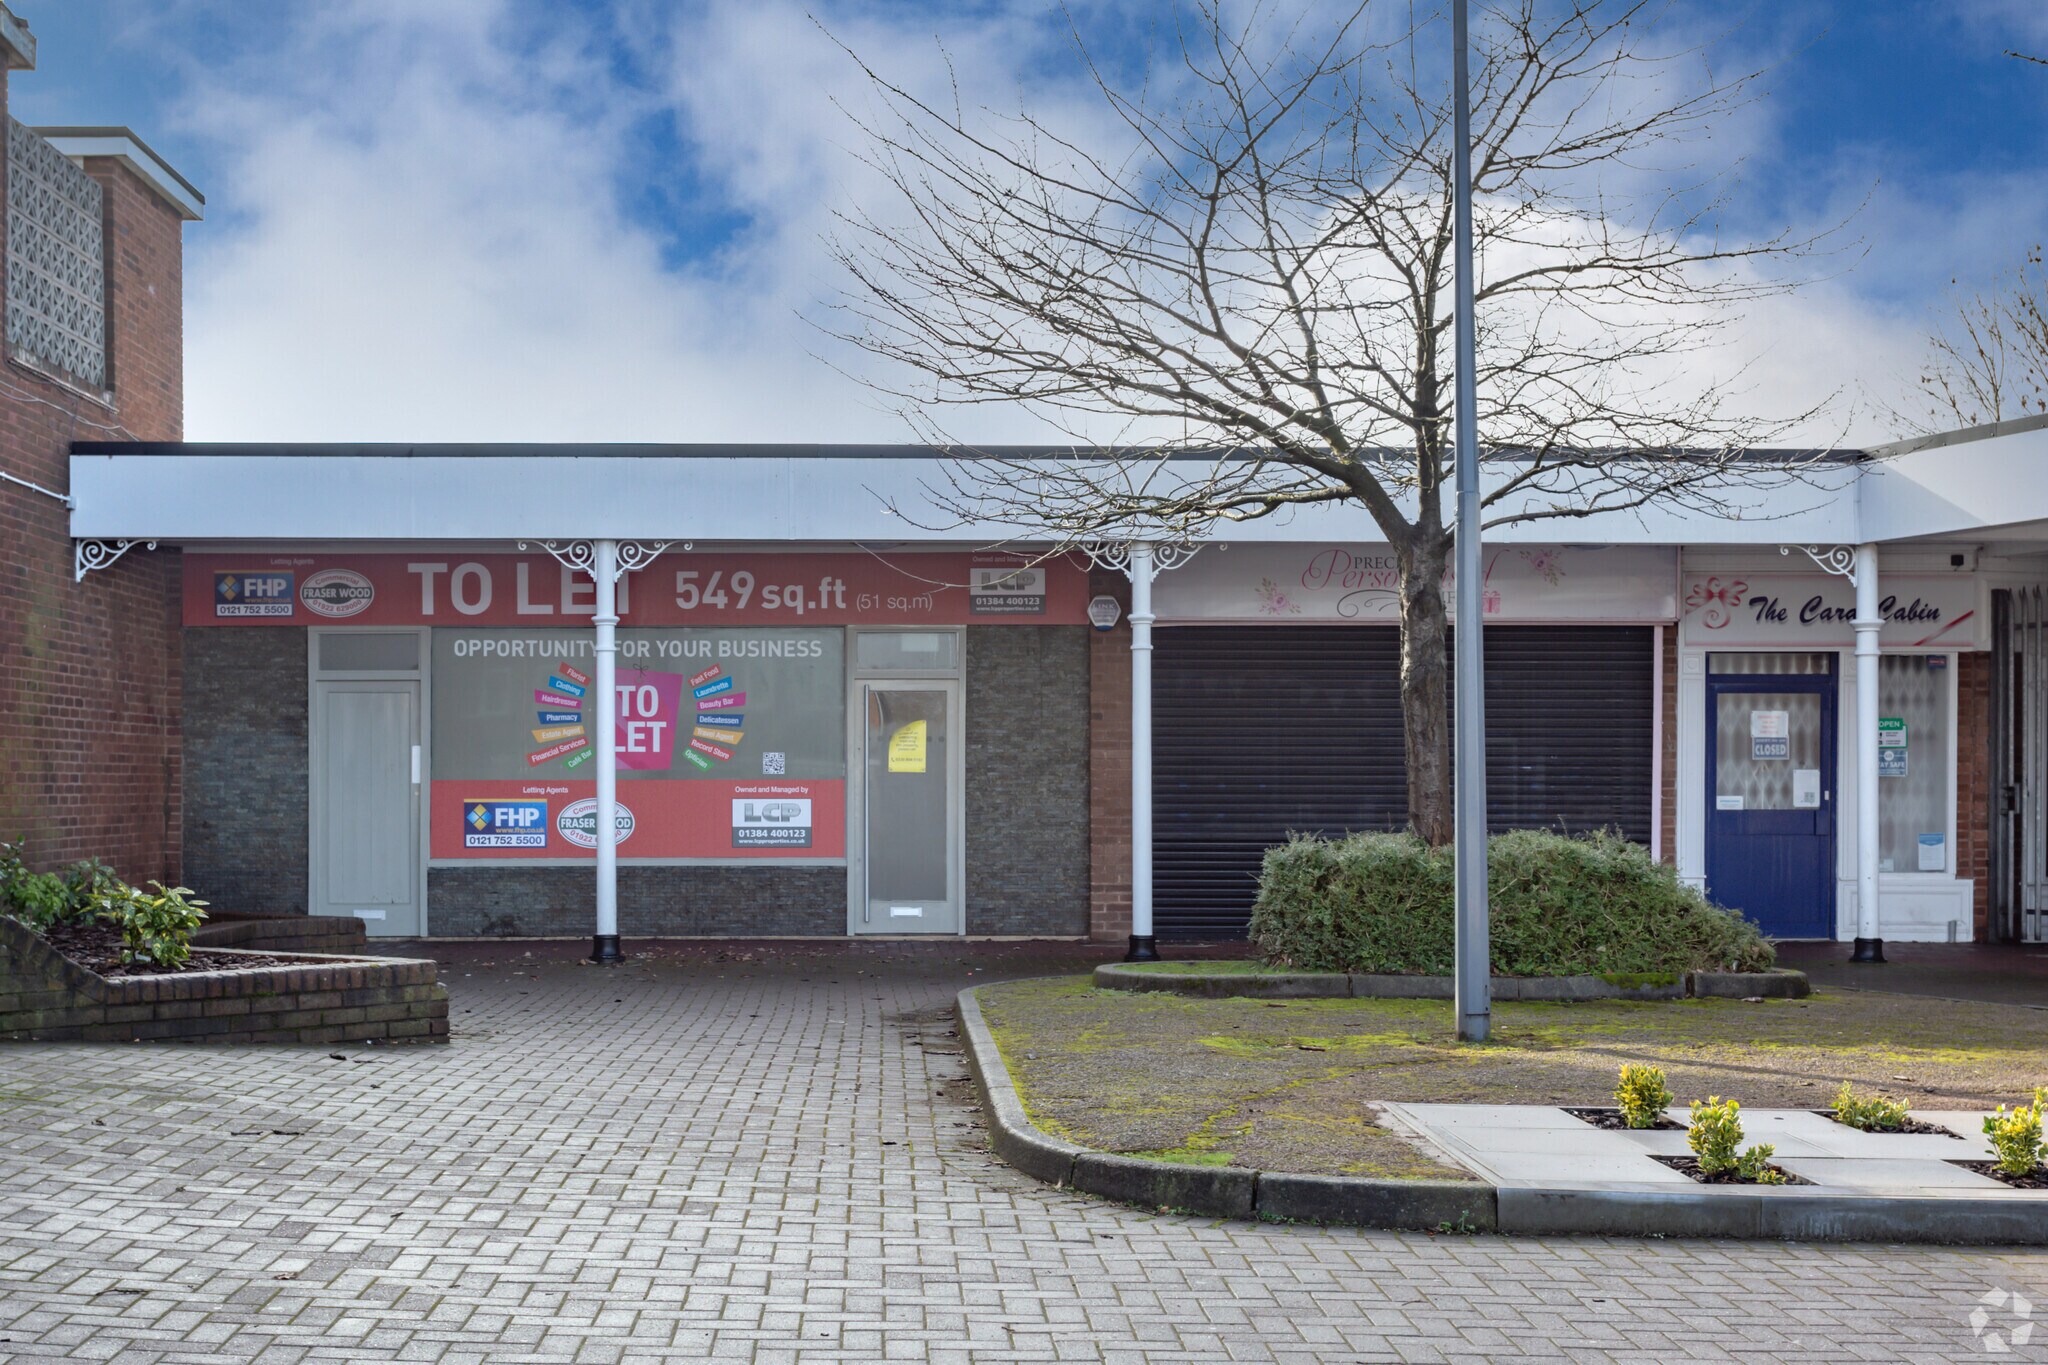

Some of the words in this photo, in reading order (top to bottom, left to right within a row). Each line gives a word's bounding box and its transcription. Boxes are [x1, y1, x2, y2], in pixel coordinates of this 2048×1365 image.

[270, 558, 292, 567] Letting
[293, 558, 315, 567] Agents
[314, 575, 360, 586] Commercial
[981, 572, 1036, 591] LCP
[244, 578, 287, 597] FHP
[303, 588, 337, 598] FRASER
[339, 588, 371, 598] WOOD
[407, 562, 493, 616] TO
[516, 562, 643, 616] LET
[675, 570, 755, 610] 549
[761, 576, 846, 615] sq.ft
[856, 593, 880, 612] (51
[887, 592, 933, 613] sq.m)
[312, 599, 335, 612] 01922
[976, 597, 1004, 605] 01384
[1006, 597, 1040, 605] 400123
[220, 605, 241, 614] 0121
[243, 605, 261, 614] 752
[264, 605, 290, 614] 5500
[1748, 596, 1788, 622] The
[1877, 595, 1941, 622] Cabin
[454, 639, 598, 657] OPPORTUNITY
[656, 640, 712, 658] YOUR
[718, 640, 823, 658] BUSINESS
[566, 667, 586, 683] Florist
[690, 674, 704, 686] Fast
[703, 666, 719, 679] Food
[555, 680, 581, 696] Clothing
[696, 682, 729, 698] Laundrette
[541, 694, 578, 707] Hairdresser
[616, 685, 659, 718] TO
[699, 700, 722, 710] Beauty
[723, 697, 734, 706] Bar
[546, 714, 578, 722] Pharmacy
[699, 716, 740, 725] Delicatessen
[1879, 720, 1900, 728] OPEN
[541, 731, 561, 739] Estate
[562, 727, 581, 737] Agent
[615, 721, 667, 753] ET
[697, 728, 715, 738] Travel
[715, 732, 734, 742] Agent
[531, 748, 560, 763] Financial
[559, 738, 586, 753] Services
[581, 749, 593, 760] Bar
[690, 739, 713, 753] Record
[712, 748, 730, 760] Store
[1755, 744, 1786, 756] CLOSED
[523, 786, 545, 795] Letting
[546, 786, 569, 795] Agents
[771, 786, 800, 794] Managed
[800, 786, 809, 794] by
[572, 804, 620, 816] Comml
[744, 803, 801, 822] LCP
[494, 808, 540, 827] FHP
[560, 818, 596, 828] FRASER
[615, 818, 631, 828] OD
[570, 829, 593, 842] 01922
[738, 829, 768, 838] 01384
[770, 829, 806, 838] 400123
[469, 836, 492, 846] 0121
[494, 836, 513, 846] 752
[515, 836, 542, 846] 5500
